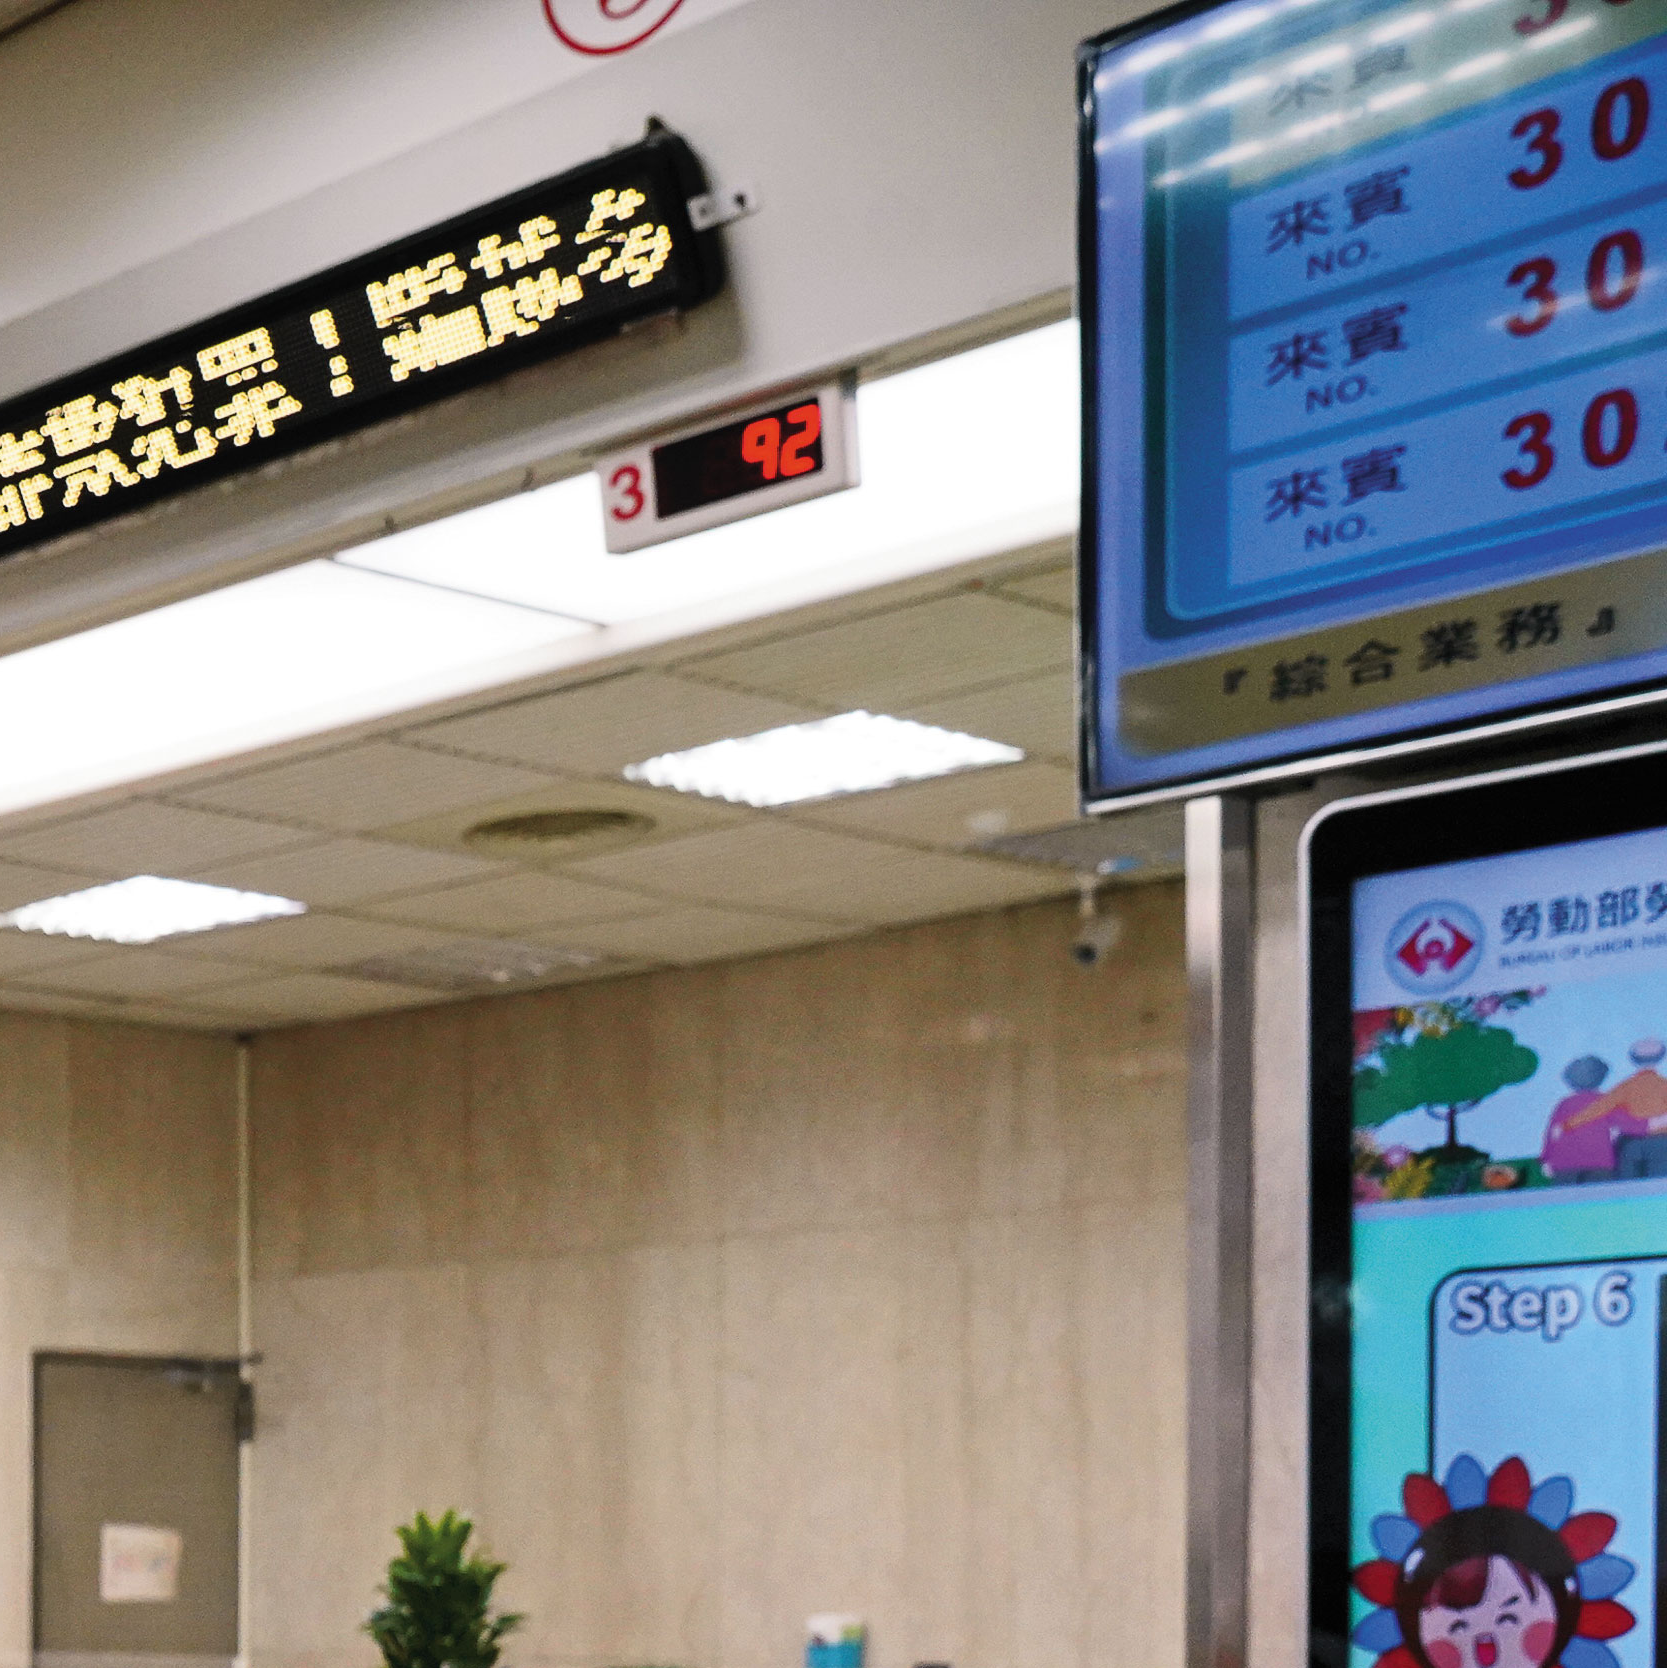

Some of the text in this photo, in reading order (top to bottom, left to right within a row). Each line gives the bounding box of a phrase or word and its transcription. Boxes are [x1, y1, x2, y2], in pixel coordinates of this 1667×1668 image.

[1266, 165, 1411, 256] 來賓
[1305, 243, 1381, 280] NO.
[1266, 303, 1409, 388] 來賓
[1304, 377, 1378, 413] NO.
[741, 404, 821, 479] 92
[609, 465, 645, 521] 3
[1266, 444, 1409, 524] 來賓
[1303, 516, 1377, 552] NO.
[1450, 1270, 1633, 1342] Step 6
